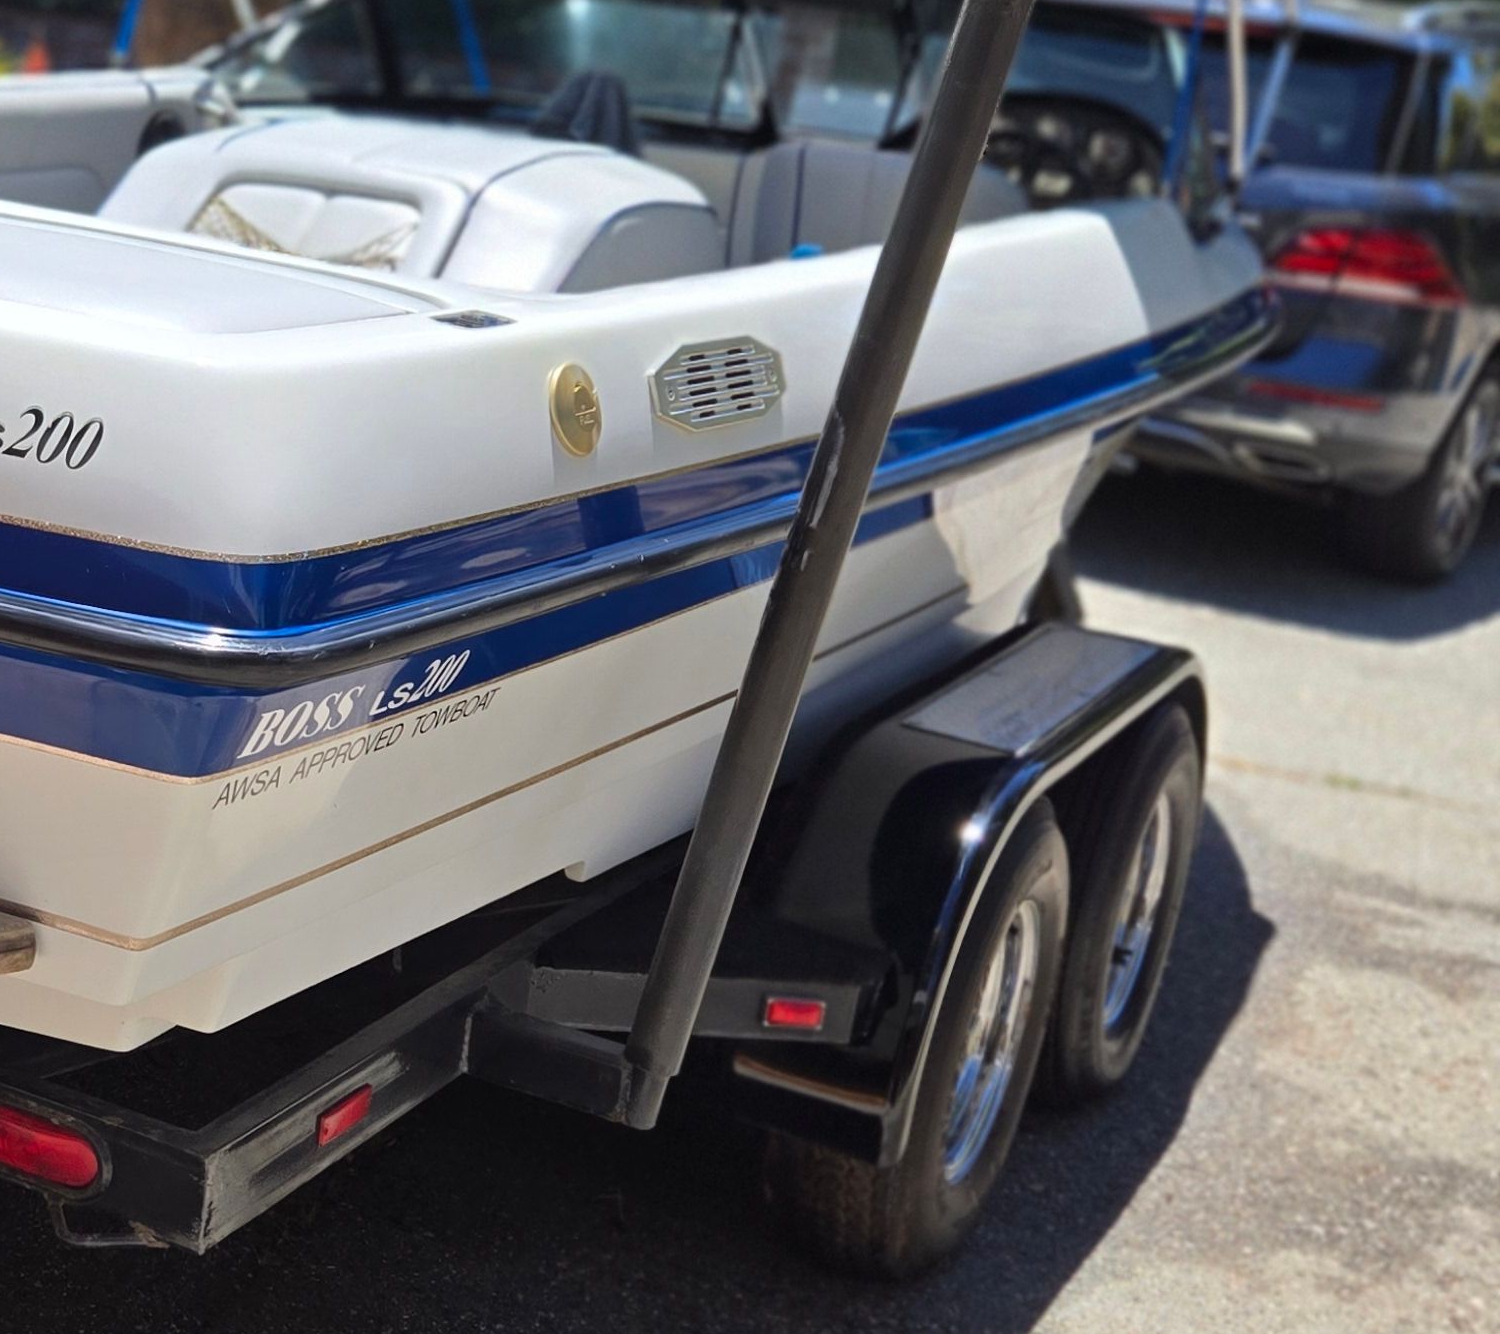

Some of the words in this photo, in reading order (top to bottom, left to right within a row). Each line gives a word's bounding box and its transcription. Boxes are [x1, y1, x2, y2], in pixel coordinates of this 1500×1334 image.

[211, 765, 282, 810] AWSA
[289, 723, 405, 784] APPROVED
[411, 687, 502, 738] TOWBOAT
[236, 684, 366, 759] BOSS
[368, 649, 471, 716] LS200
